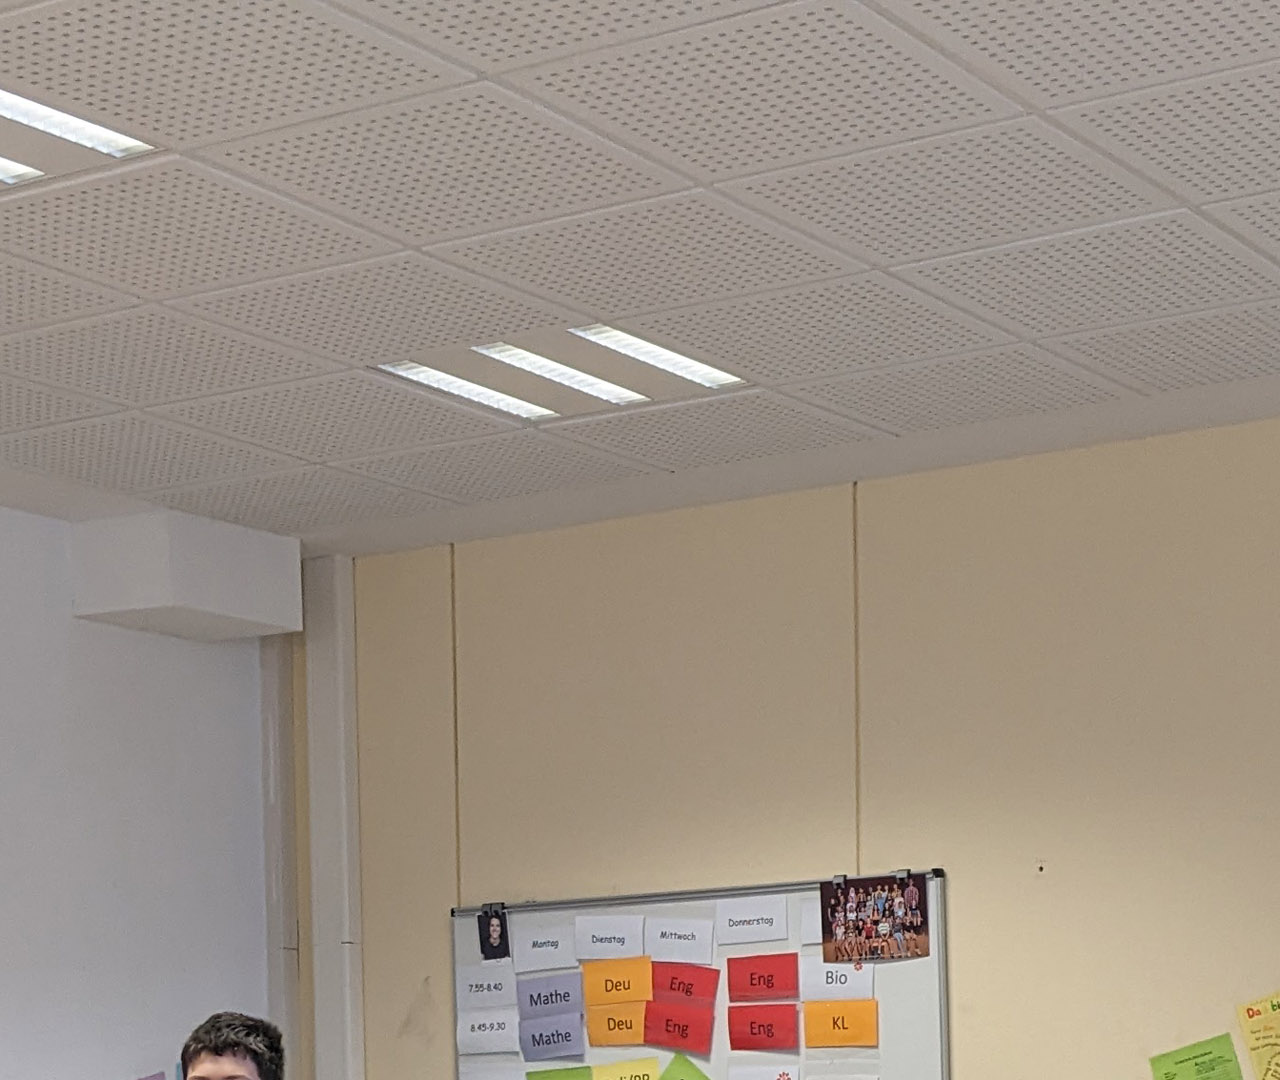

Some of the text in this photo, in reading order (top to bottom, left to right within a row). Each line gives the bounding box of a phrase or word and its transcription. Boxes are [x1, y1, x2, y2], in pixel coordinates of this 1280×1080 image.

[532, 916, 773, 949] Montag Dienstag Mittwoch Donnerstag
[468, 971, 848, 1007] 7.55-8.40 Mathe Deu Eng Eng Bio
[1246, 1007, 1261, 1019] Da
[470, 1016, 849, 1047] 8.45-9.30 Mathe Deu Eng Eng KL
